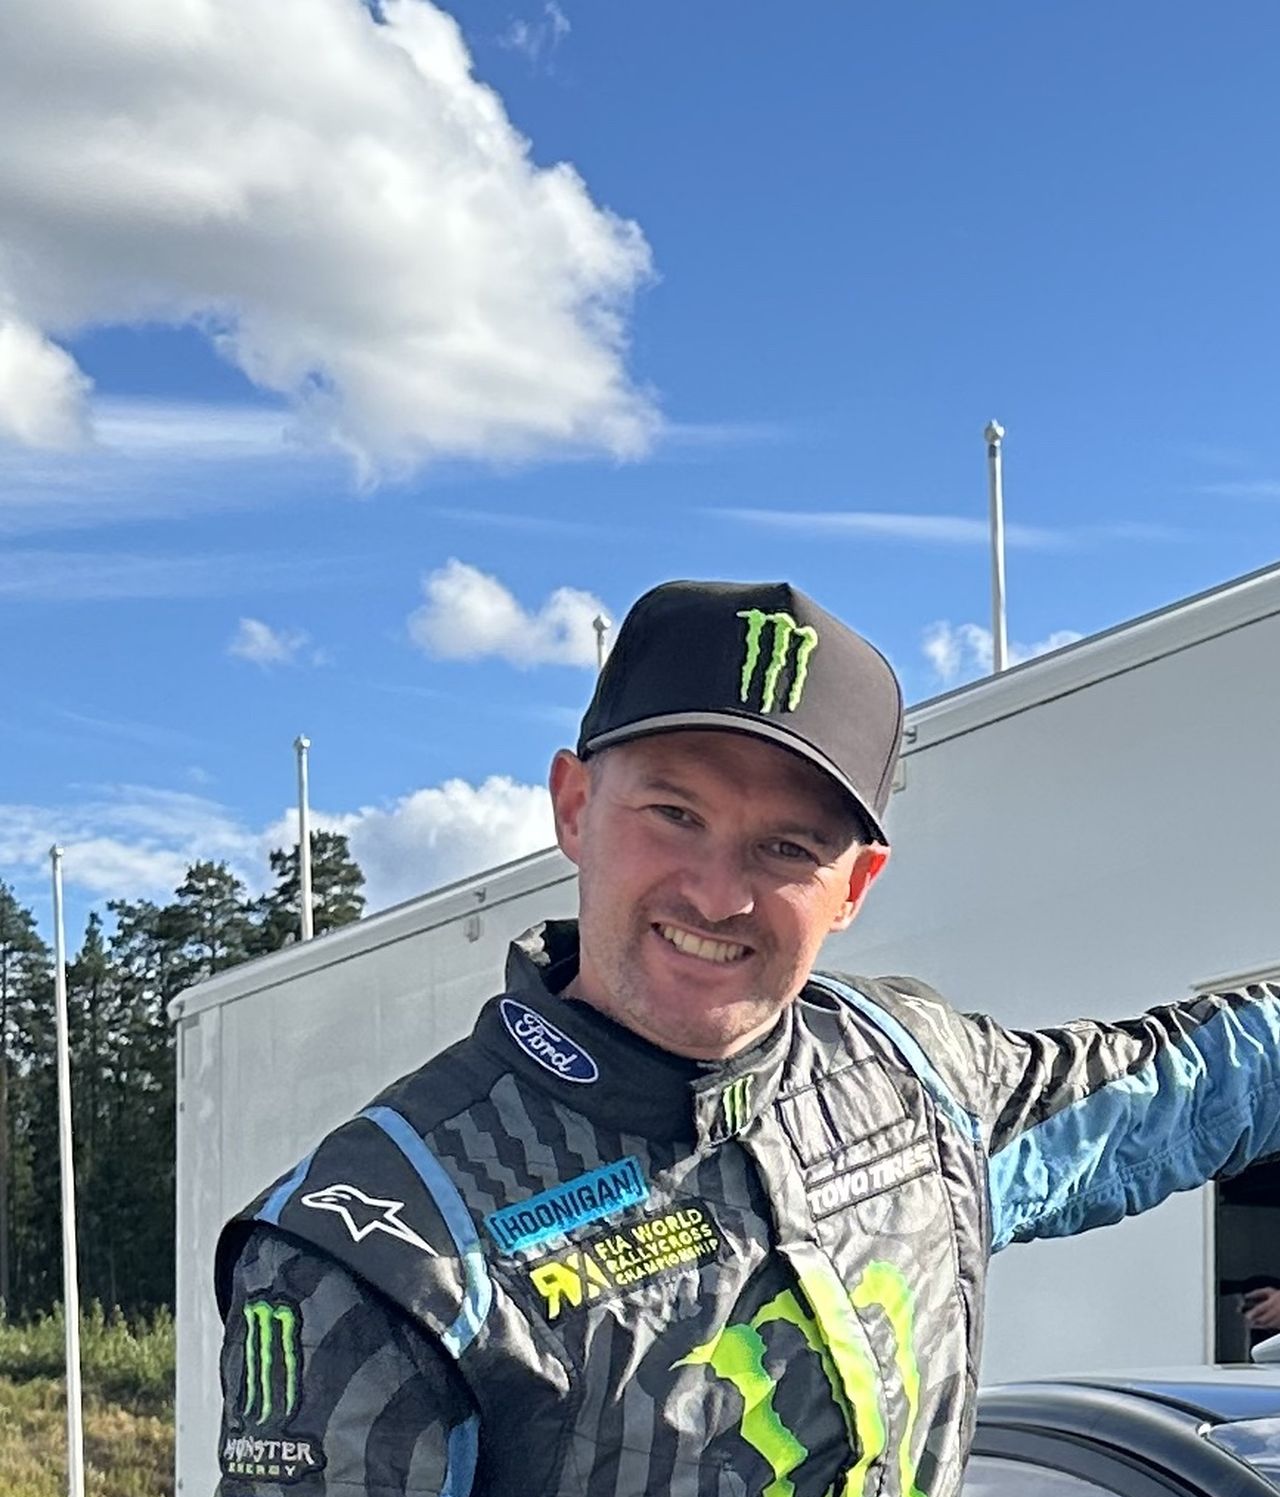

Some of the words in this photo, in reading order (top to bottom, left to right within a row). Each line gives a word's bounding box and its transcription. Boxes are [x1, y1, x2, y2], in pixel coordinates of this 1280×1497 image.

[514, 1013, 577, 1072] Ford
[807, 1170, 869, 1214] TOYO
[594, 1234, 632, 1261] FIA
[632, 1208, 702, 1244] WORLD
[605, 1223, 713, 1275] RALLYCROSS
[615, 1238, 719, 1286] CHAMPIONSHIP
[223, 1436, 315, 1465] MONSTER
